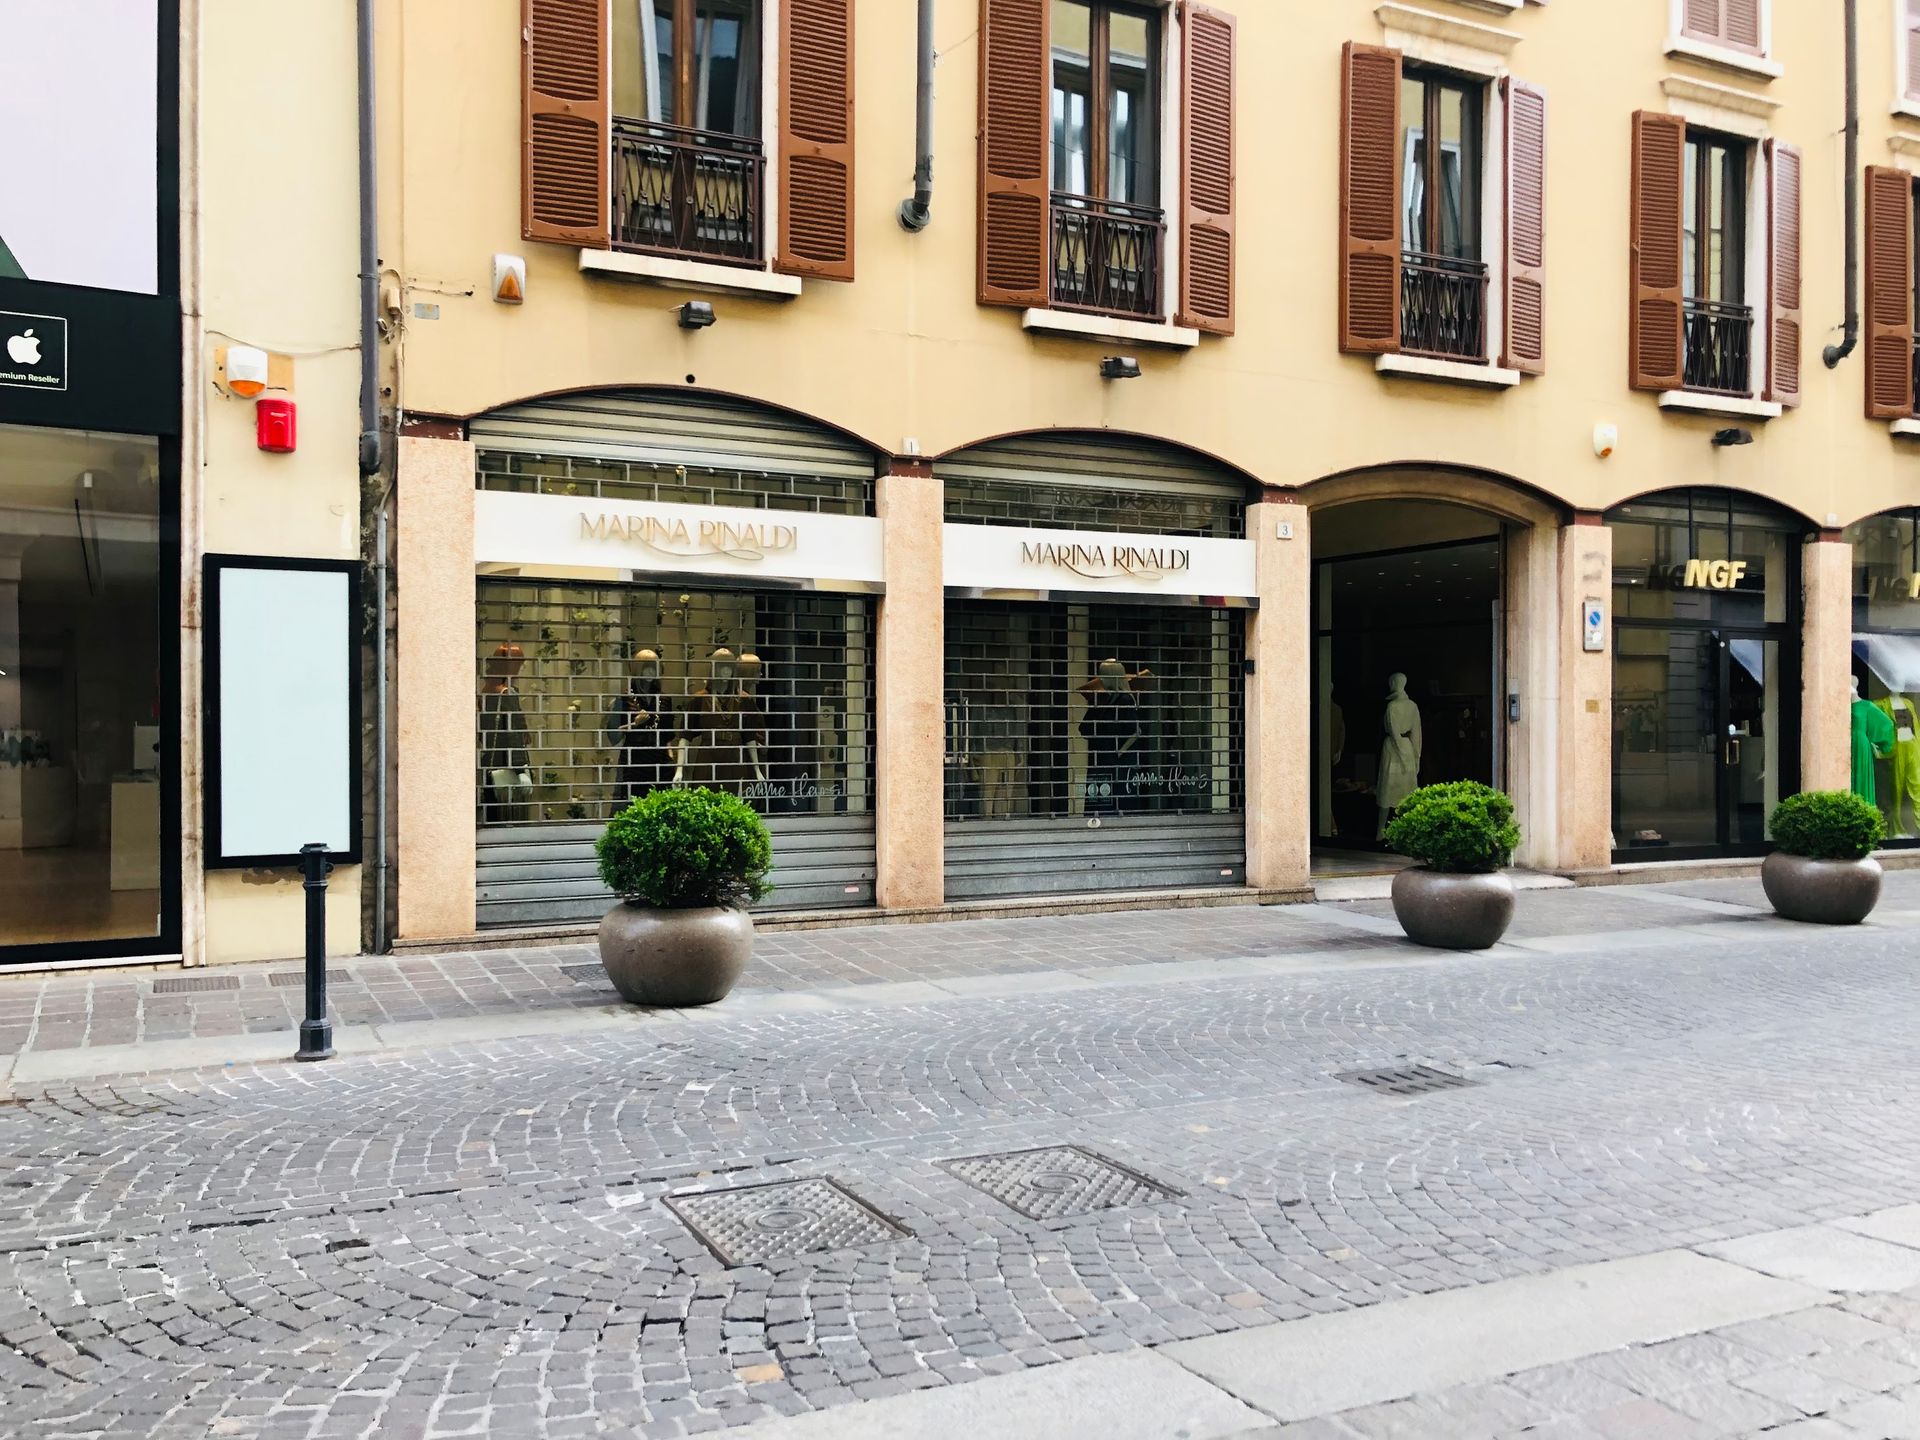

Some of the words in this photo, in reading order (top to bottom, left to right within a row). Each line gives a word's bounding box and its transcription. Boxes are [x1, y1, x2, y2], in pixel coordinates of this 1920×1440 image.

[28, 373, 60, 384] Reseller
[580, 512, 691, 555] MARINA
[699, 519, 798, 560] RINALDI
[1282, 524, 1289, 536] 3
[1022, 541, 1106, 578] MARINA
[1113, 545, 1190, 580] RINALDI
[1683, 559, 1747, 588] NGF
